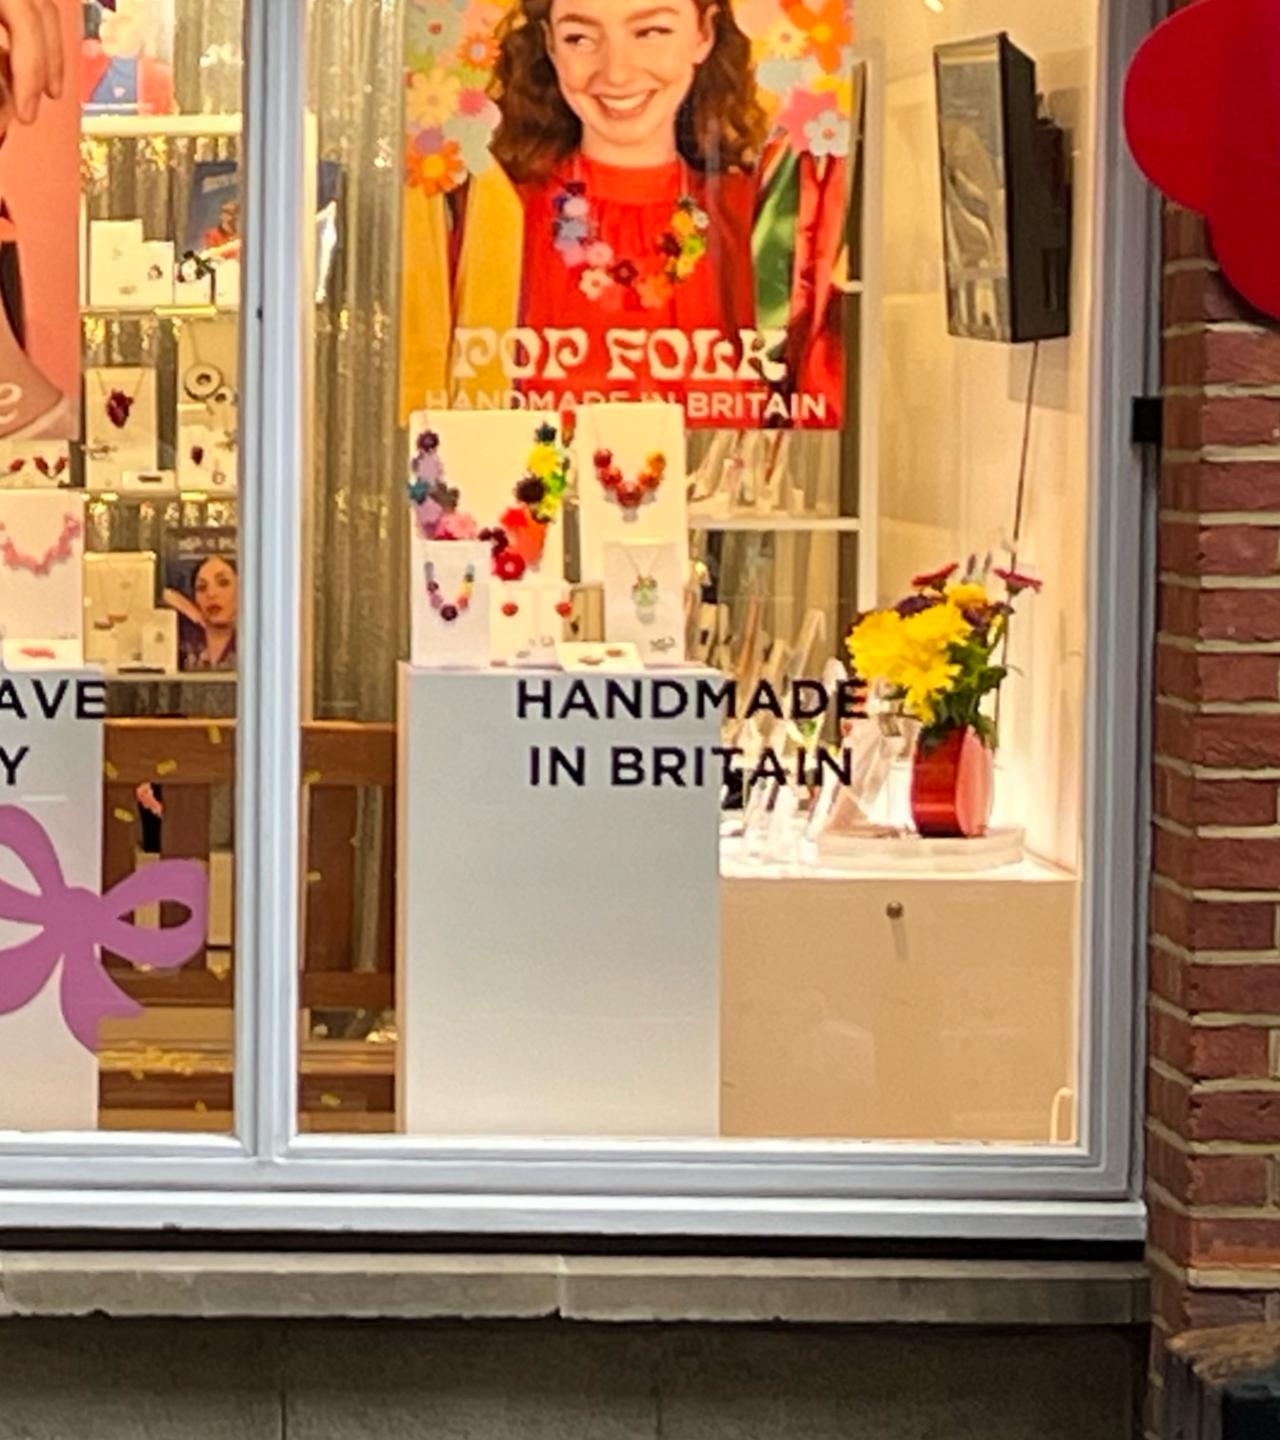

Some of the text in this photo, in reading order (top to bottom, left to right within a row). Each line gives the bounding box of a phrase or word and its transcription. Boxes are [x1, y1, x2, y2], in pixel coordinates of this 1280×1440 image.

[453, 327, 788, 381] POP FOLK
[686, 391, 827, 421] BRITAIN
[517, 679, 869, 720] HANDMADE
[530, 746, 853, 787] IN BRITAIN
